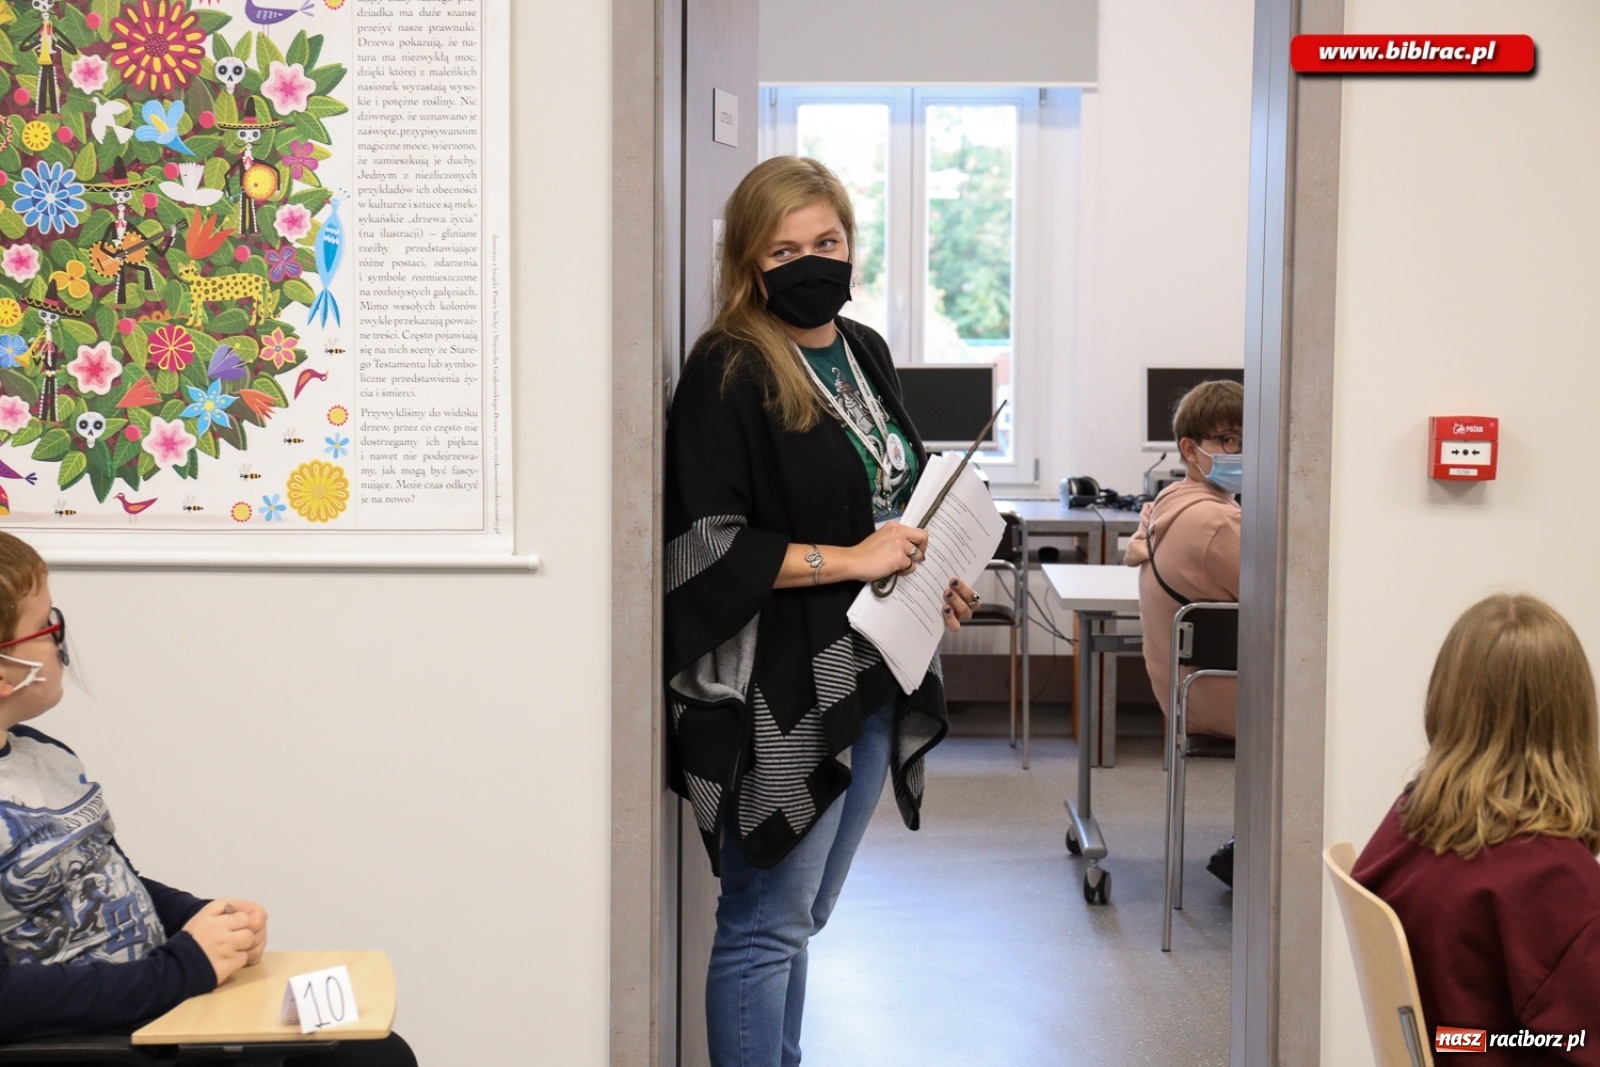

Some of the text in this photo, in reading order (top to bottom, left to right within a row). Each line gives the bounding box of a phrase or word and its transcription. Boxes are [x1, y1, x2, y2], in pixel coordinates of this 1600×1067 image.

[357, 7, 393, 17] dziadka
[419, 7, 441, 17] duże
[357, 22, 392, 35] przeżyć
[429, 22, 476, 35] prawnuki.
[358, 37, 394, 47] Drzewa
[448, 37, 458, 47] że
[358, 54, 376, 62] tura
[402, 52, 449, 65] niezwykłą
[357, 67, 384, 80] dzięki
[389, 67, 416, 80] której
[429, 67, 477, 77] maleńkich
[358, 81, 476, 94] nasionek wyrastają wyso-
[358, 96, 371, 106] kie
[383, 96, 418, 109] potężne
[423, 96, 456, 109] rośliny.
[461, 96, 477, 106] Nic
[407, 111, 417, 121] że
[470, 111, 477, 124] je
[358, 140, 401, 153] magiczne
[358, 155, 477, 168] że zamieszkują je duchy.
[357, 170, 397, 183] Jednym
[415, 170, 477, 183] niezliczonych
[358, 184, 477, 197] przykładów ich obecności
[369, 199, 407, 209] kulturze
[413, 201, 442, 209] sztuce
[443, 202, 453, 212] są
[454, 199, 477, 209] mek-
[358, 213, 404, 226] sykańskie
[359, 228, 374, 241] (na
[380, 228, 424, 241] ilustracji)
[441, 228, 477, 241] gliniane
[359, 243, 477, 256] rzeźby przedstawiające
[359, 257, 384, 267] różne
[434, 257, 477, 267] zdarzenia
[368, 272, 406, 285] symbole
[412, 272, 477, 282] rozmieszczone
[373, 286, 431, 299] rozłożystych
[433, 286, 477, 299] gałęziach.
[360, 301, 477, 314] Mimo wesołych kolorów
[360, 315, 477, 328] zwykle przekazują poważ-
[373, 330, 400, 340] treści.
[402, 330, 433, 343] Często
[435, 330, 477, 343] pojawiają
[360, 344, 372, 357] się
[388, 344, 408, 354] nich
[410, 347, 435, 357] sceny
[450, 344, 477, 354] Stare-
[360, 359, 477, 372] go Testamentu lub symbo-
[360, 373, 477, 386] liczne przedstawienia ży-
[360, 388, 373, 398] cia
[382, 388, 417, 398] śmierci.
[361, 407, 478, 420] Przywykliśmy do widoku
[394, 425, 418, 435] przez
[434, 424, 462, 435] często
[465, 422, 478, 432] nie
[360, 436, 478, 449] dostrzegamy ich piękna
[370, 453, 397, 461] nawet
[403, 451, 417, 461] nie
[423, 451, 478, 464] podejrzewa-
[382, 465, 396, 478] jak
[401, 468, 426, 478] mogą
[431, 465, 447, 478] być
[452, 465, 478, 478] fascy-
[361, 479, 393, 492] nujące.
[396, 479, 422, 489] Może
[446, 479, 478, 492] odkryć
[361, 494, 368, 507] je
[385, 494, 415, 504] nowo?
[303, 975, 345, 1028] 10
